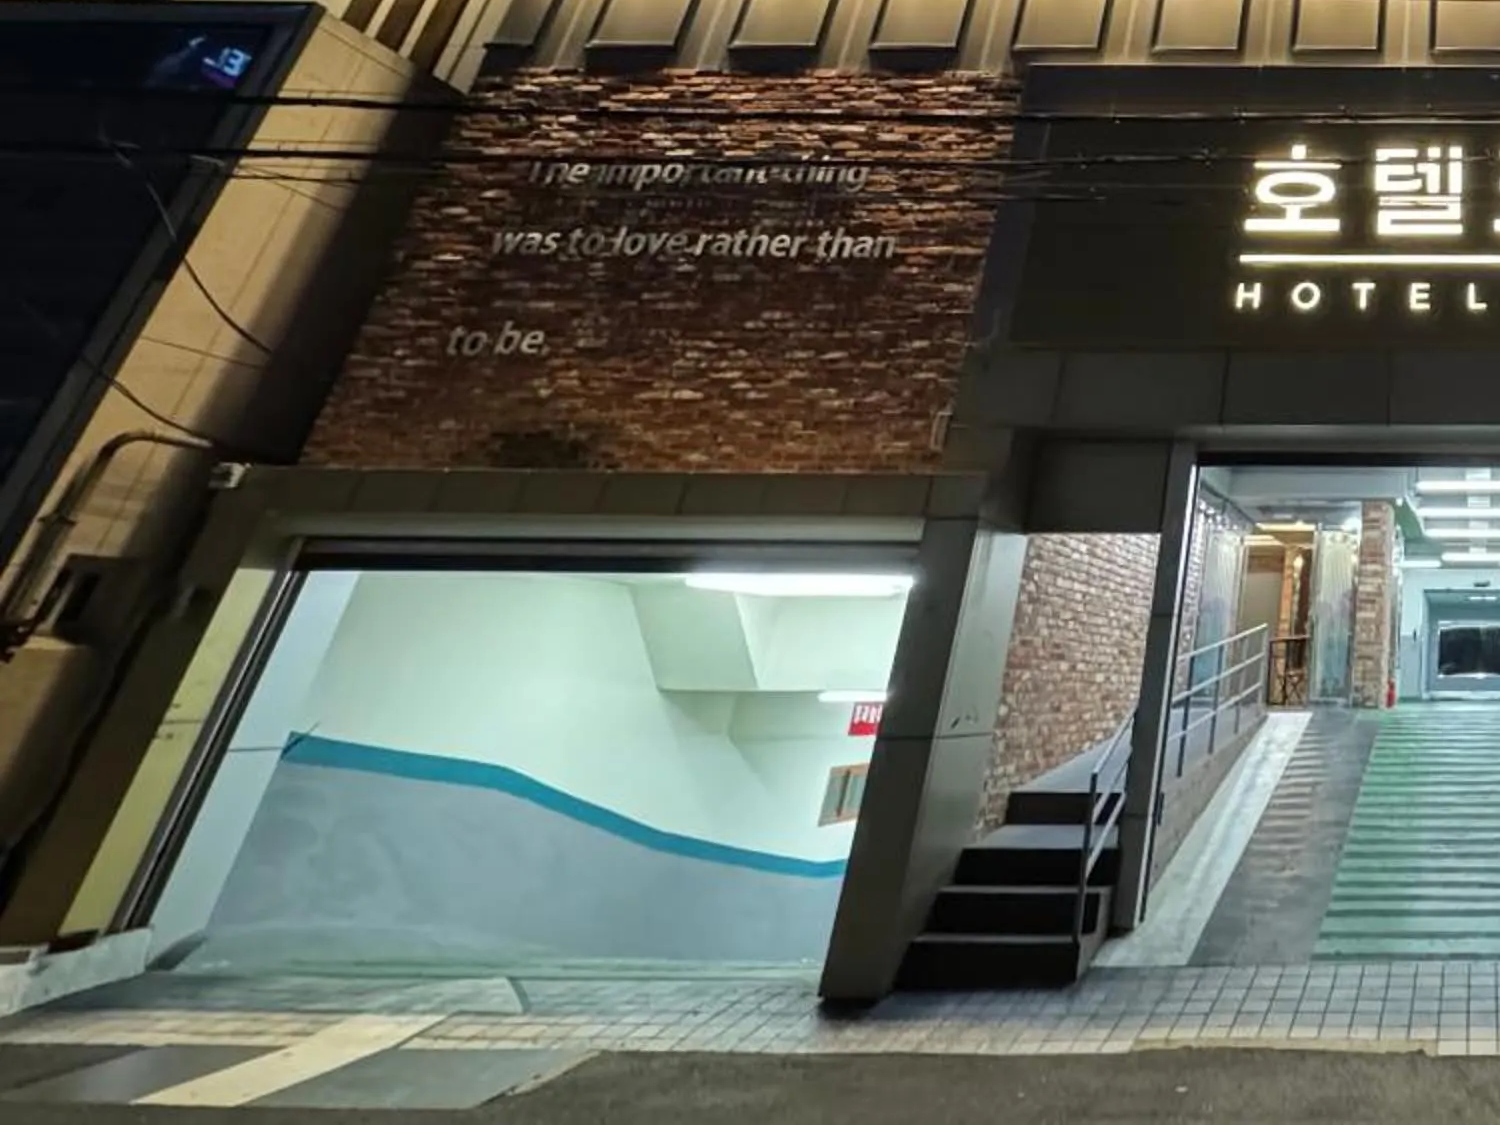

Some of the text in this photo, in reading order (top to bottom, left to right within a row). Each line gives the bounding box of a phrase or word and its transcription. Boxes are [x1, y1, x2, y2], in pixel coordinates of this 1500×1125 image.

[493, 223, 897, 260] was to love rather than
[446, 325, 489, 356] to
